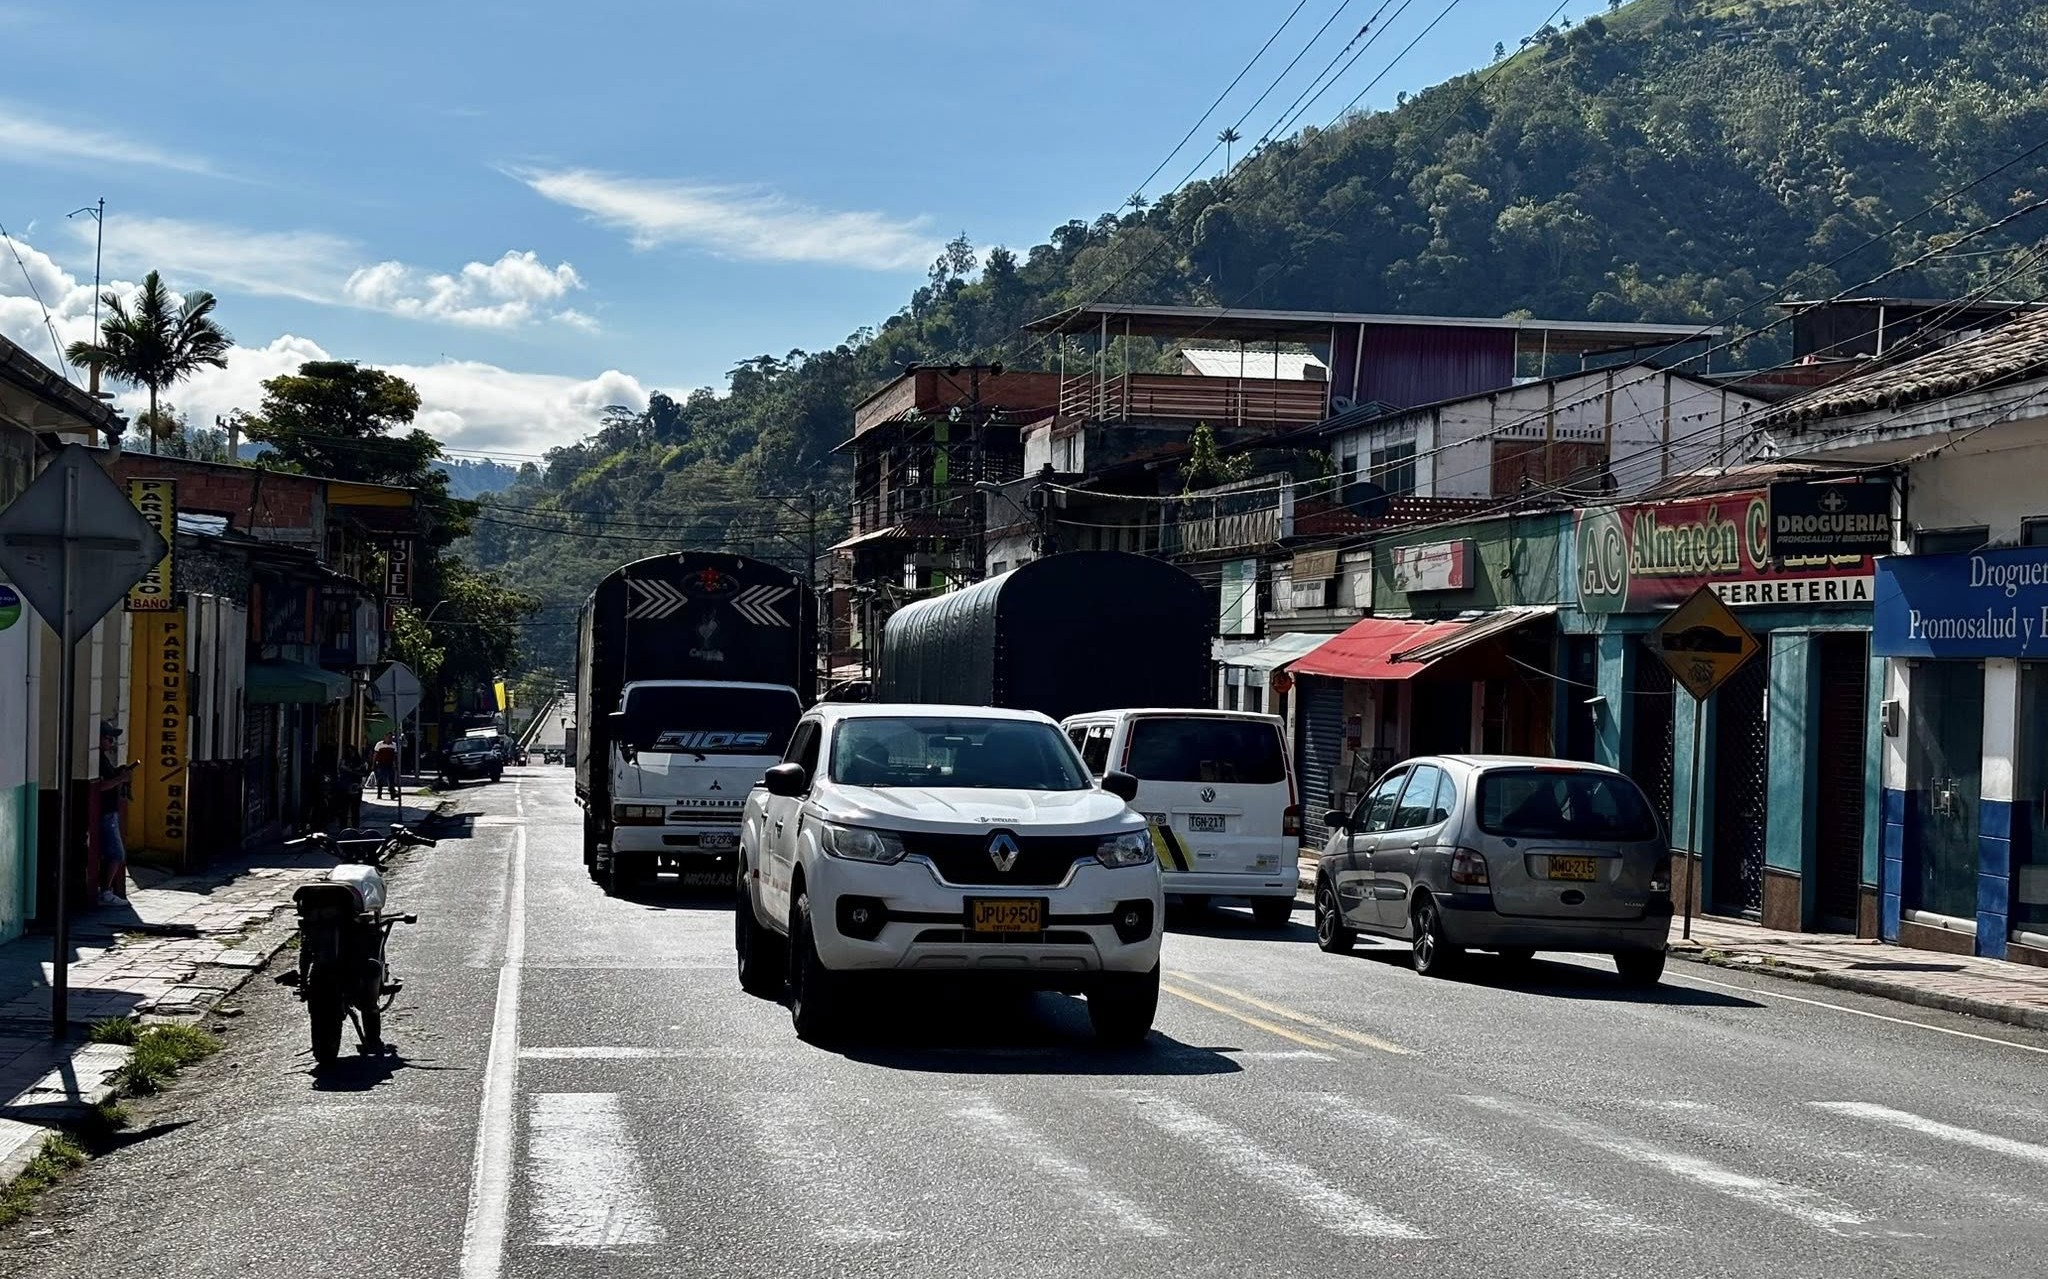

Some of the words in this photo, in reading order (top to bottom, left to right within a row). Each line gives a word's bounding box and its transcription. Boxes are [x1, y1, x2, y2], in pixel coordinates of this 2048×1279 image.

[1630, 503, 1740, 574] Almacén
[1776, 535, 1833, 543] PROMOSALUD
[1835, 535, 1842, 543] Y
[1842, 534, 1889, 542] BIENESTAR
[1777, 514, 1889, 533] DROGUERIA
[391, 540, 406, 596] HOTEL
[1584, 526, 1623, 594] AC
[133, 597, 168, 609] BAÑO
[1718, 579, 1867, 603] FERRETERIA
[1908, 606, 2017, 640] Promosalud
[2022, 617, 2035, 650] y
